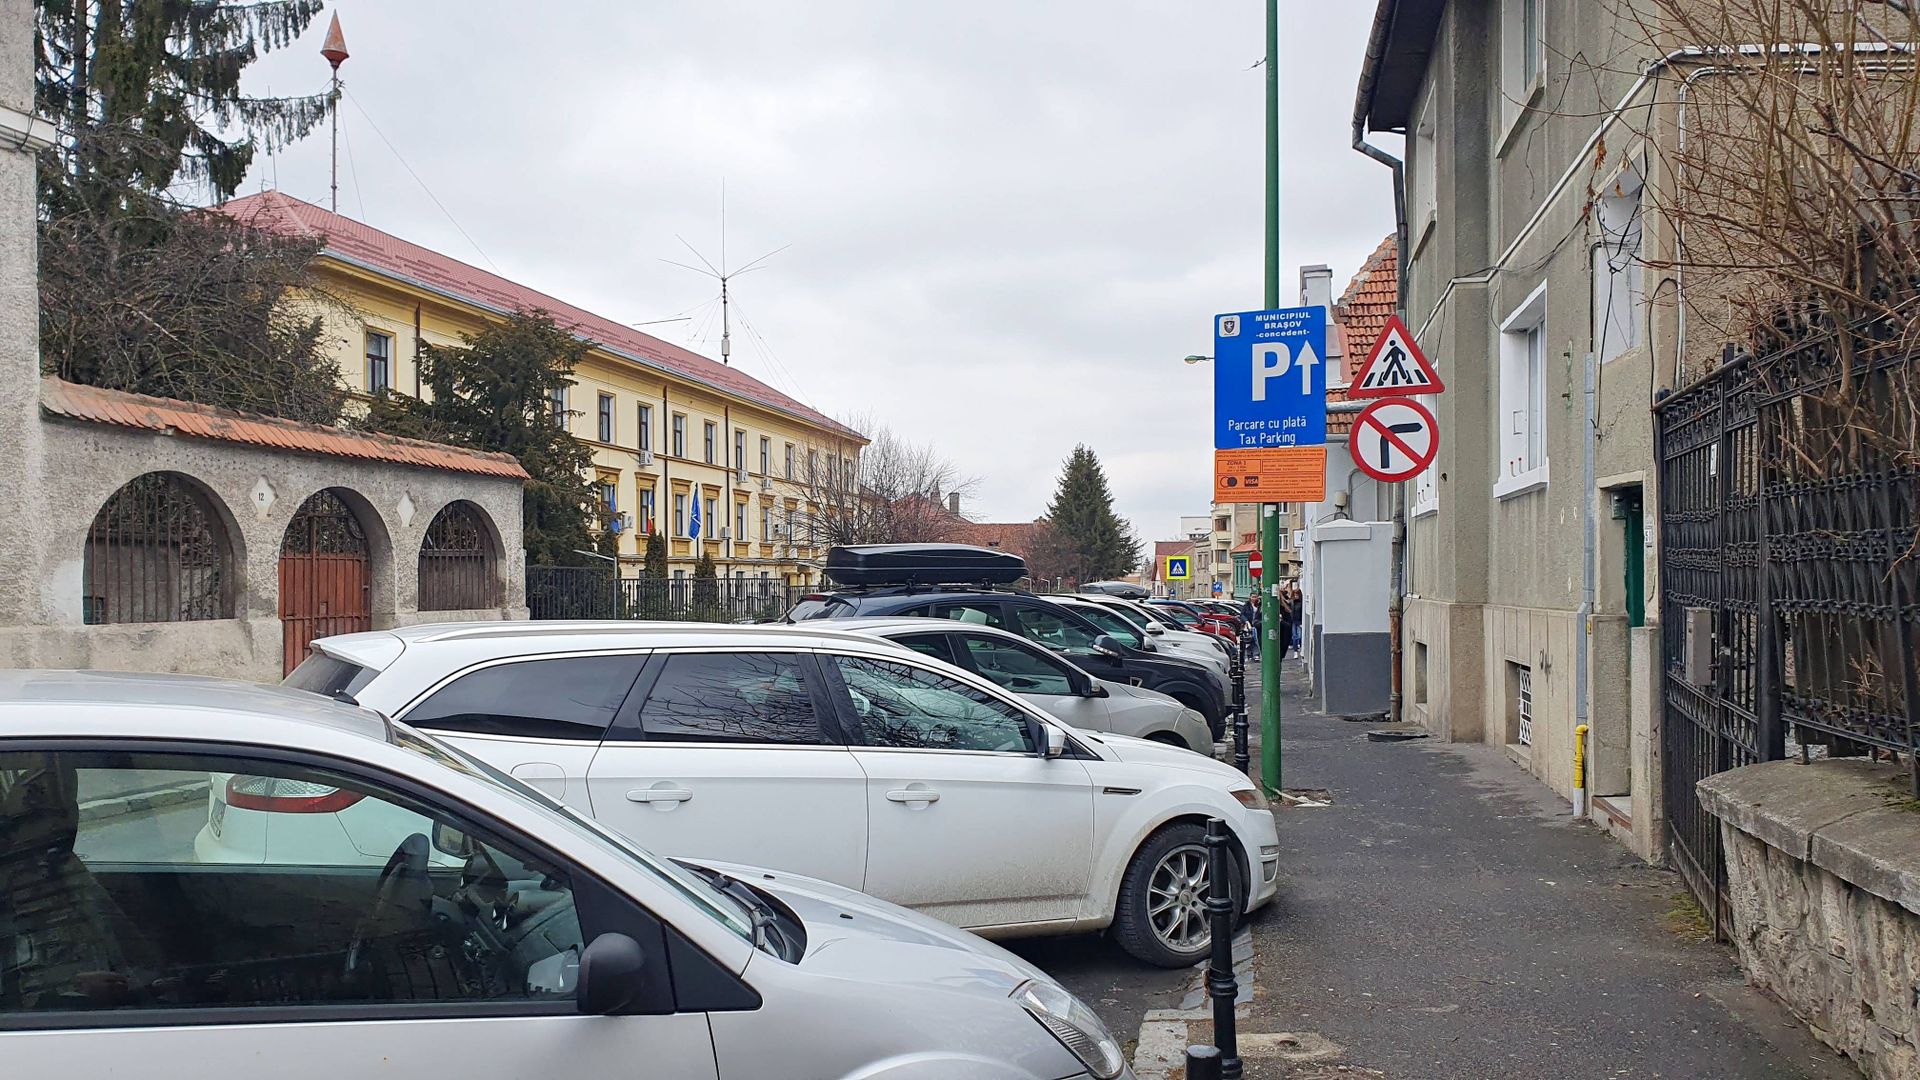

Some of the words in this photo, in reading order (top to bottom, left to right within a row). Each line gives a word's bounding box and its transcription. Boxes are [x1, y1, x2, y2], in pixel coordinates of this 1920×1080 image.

[1255, 312, 1311, 322] MUNICIPIUL
[1255, 329, 1310, 338] -concedent-
[1252, 342, 1290, 401] P
[1228, 419, 1265, 431] Parcare
[1268, 419, 1280, 429] cu
[1283, 416, 1307, 430] plată
[1240, 433, 1256, 445] Tax
[1260, 431, 1296, 445] Parking
[258, 492, 265, 501] 12
